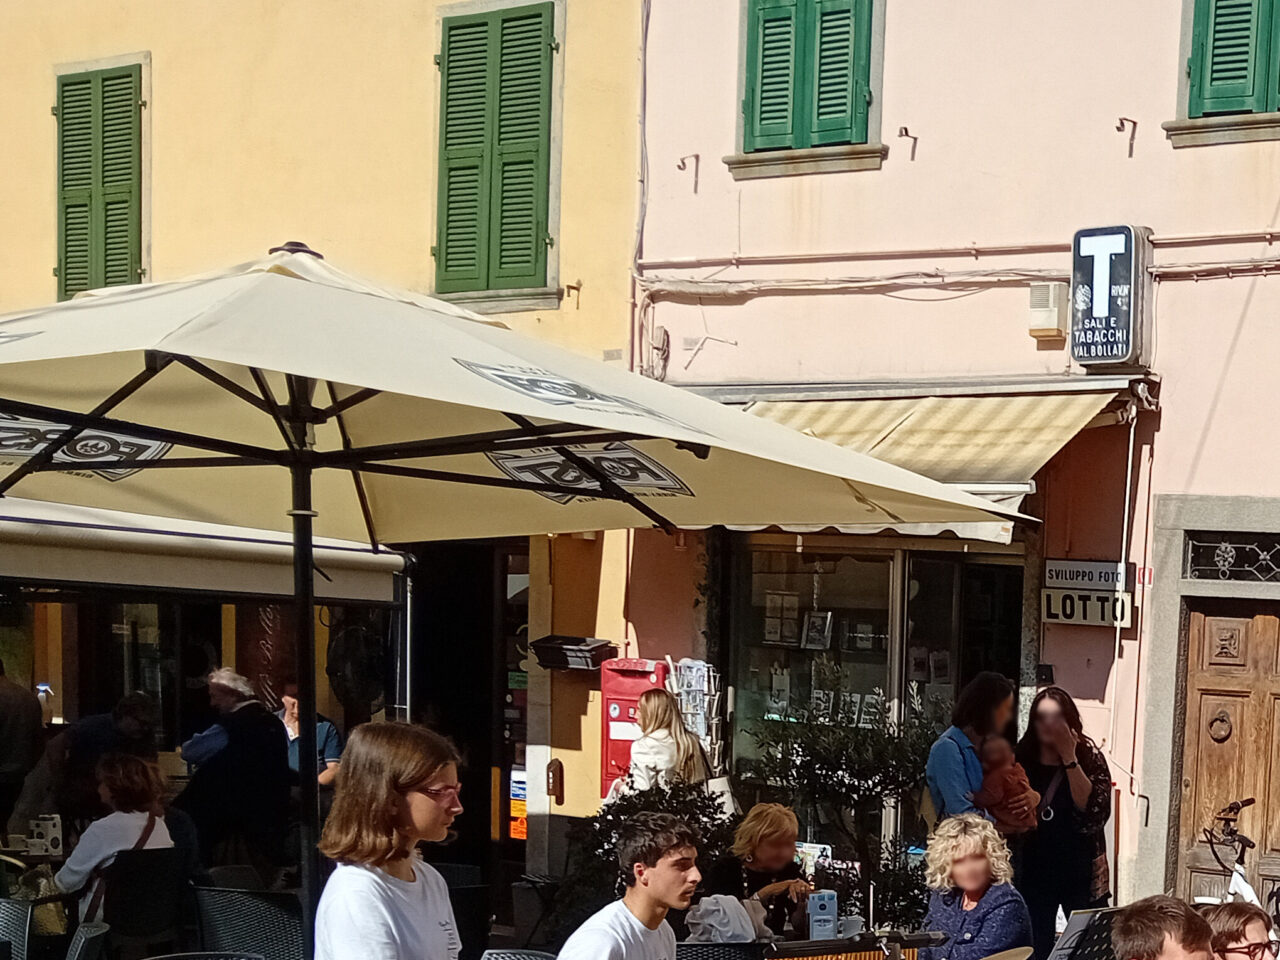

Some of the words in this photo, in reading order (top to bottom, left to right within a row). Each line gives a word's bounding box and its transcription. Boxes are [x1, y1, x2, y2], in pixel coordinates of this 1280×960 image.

[1079, 234, 1126, 318] T
[1084, 318, 1106, 329] SALI
[1110, 317, 1117, 327] E
[1074, 329, 1127, 343] TABACCHI
[1048, 569, 1094, 582] SVILUPPO
[1046, 593, 1125, 622] LOTTO
